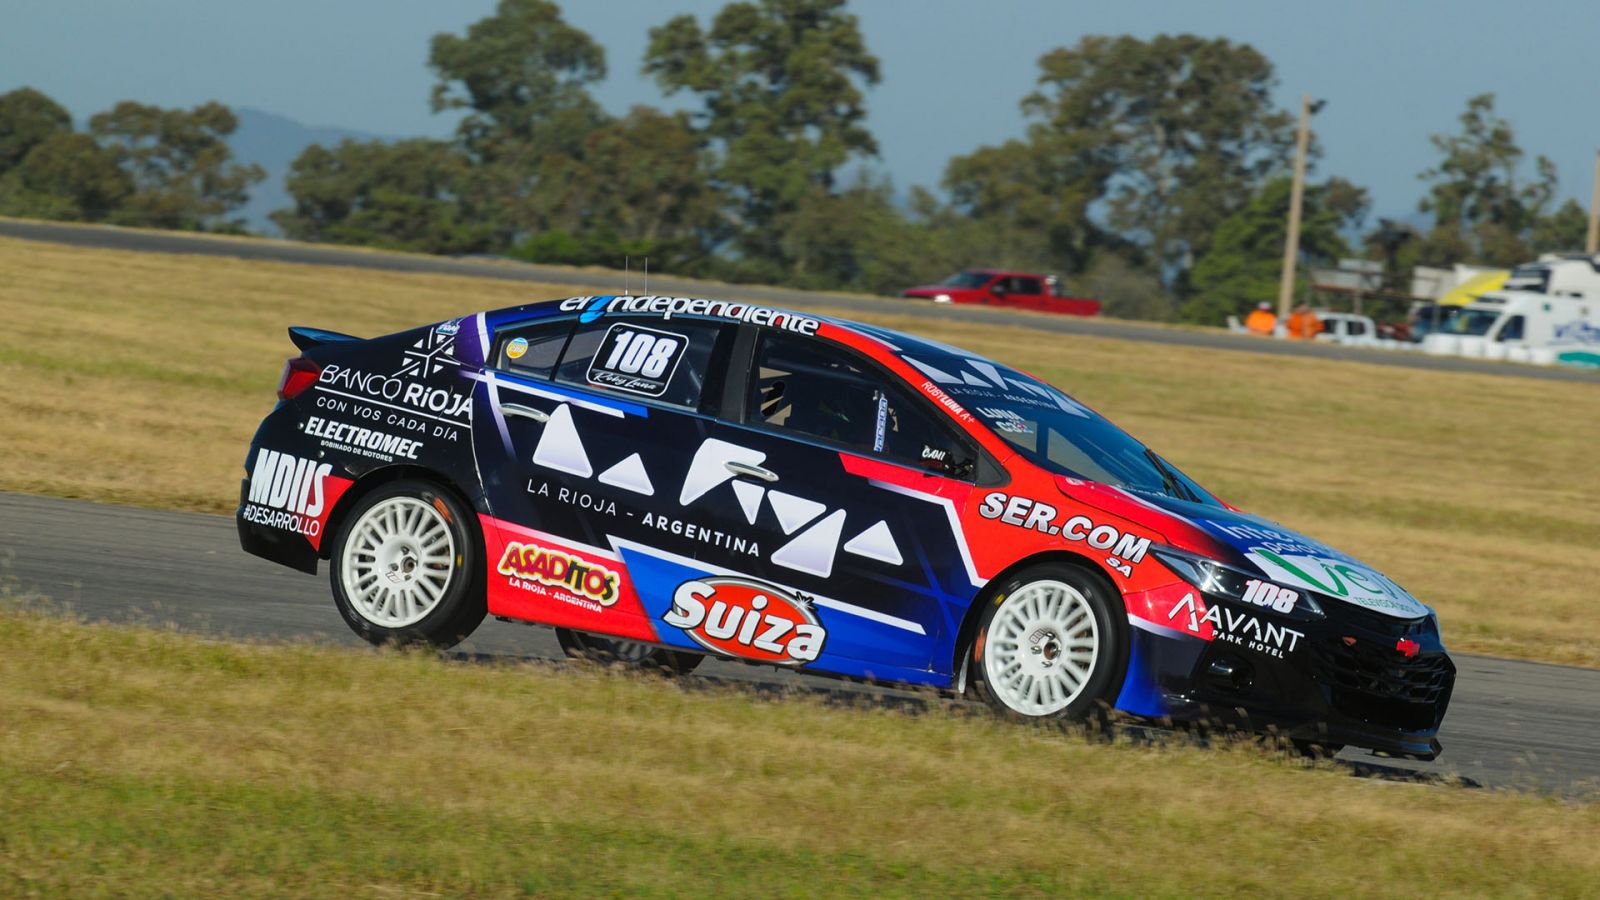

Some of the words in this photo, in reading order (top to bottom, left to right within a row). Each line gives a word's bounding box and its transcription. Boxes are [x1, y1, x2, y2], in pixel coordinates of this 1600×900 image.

[604, 330, 679, 379] 108
[318, 363, 403, 400] BANCO
[625, 378, 657, 390] Luna
[316, 396, 347, 413] CON
[352, 405, 382, 421] VOS
[387, 414, 427, 437] CADA
[433, 425, 458, 442] DÍA
[304, 416, 424, 460] ELECTROMEC
[320, 440, 352, 453] BOBINADO
[352, 447, 362, 455] DE
[362, 450, 393, 462] MOTORES
[243, 504, 320, 538] #DESARROLLO
[527, 479, 548, 496] LA
[558, 487, 618, 516] RIOJA
[642, 511, 760, 558] ARGENTINA
[979, 492, 1152, 565] SER.COM
[502, 546, 615, 601] ASADITOS
[1106, 557, 1133, 578] SA
[509, 578, 521, 589] LA
[553, 591, 602, 613] ARGENTINA
[1241, 579, 1300, 614] 108
[663, 580, 826, 663] Suiza
[1212, 630, 1243, 645] PARK
[1248, 641, 1284, 659] HOTEL
